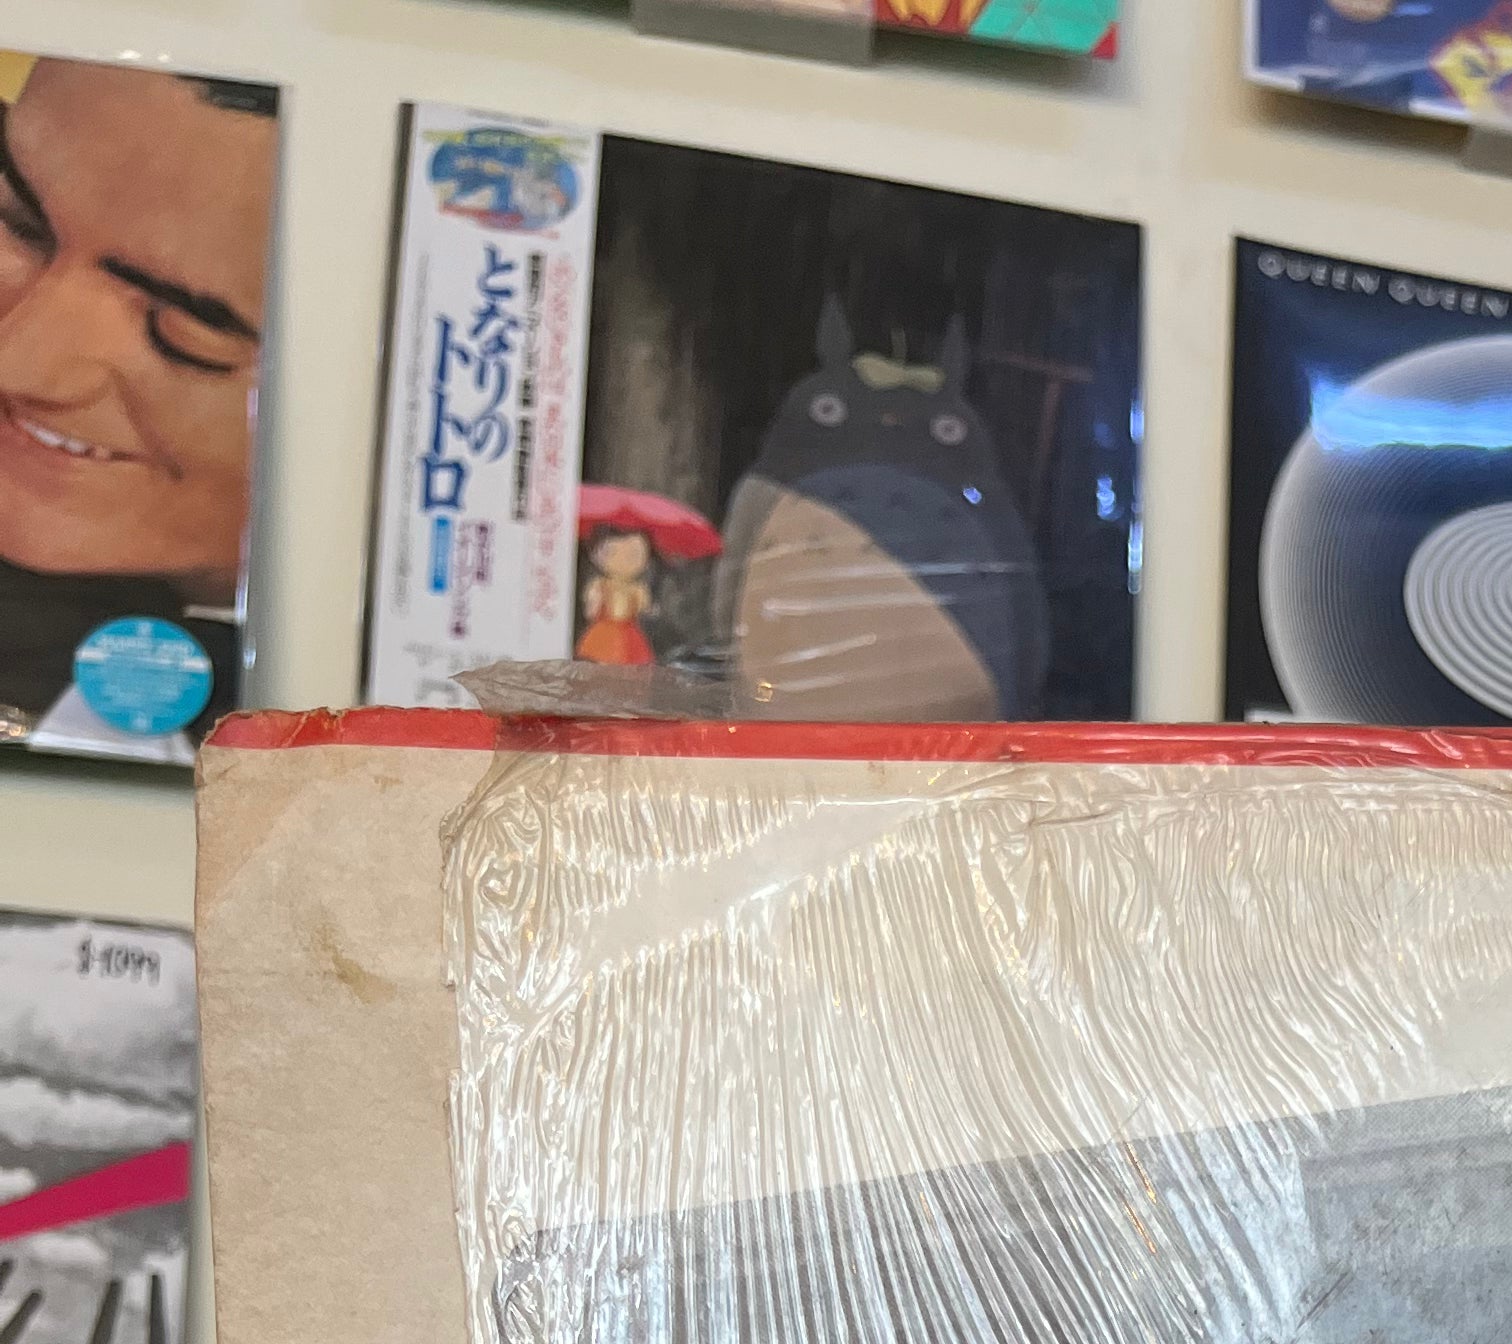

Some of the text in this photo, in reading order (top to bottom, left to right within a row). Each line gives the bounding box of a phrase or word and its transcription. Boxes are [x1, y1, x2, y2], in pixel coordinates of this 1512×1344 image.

[473, 240, 522, 464] となりの
[1257, 250, 1381, 296] QUEEN
[1388, 275, 1510, 320] QUEEN
[419, 312, 473, 513] トトロ
